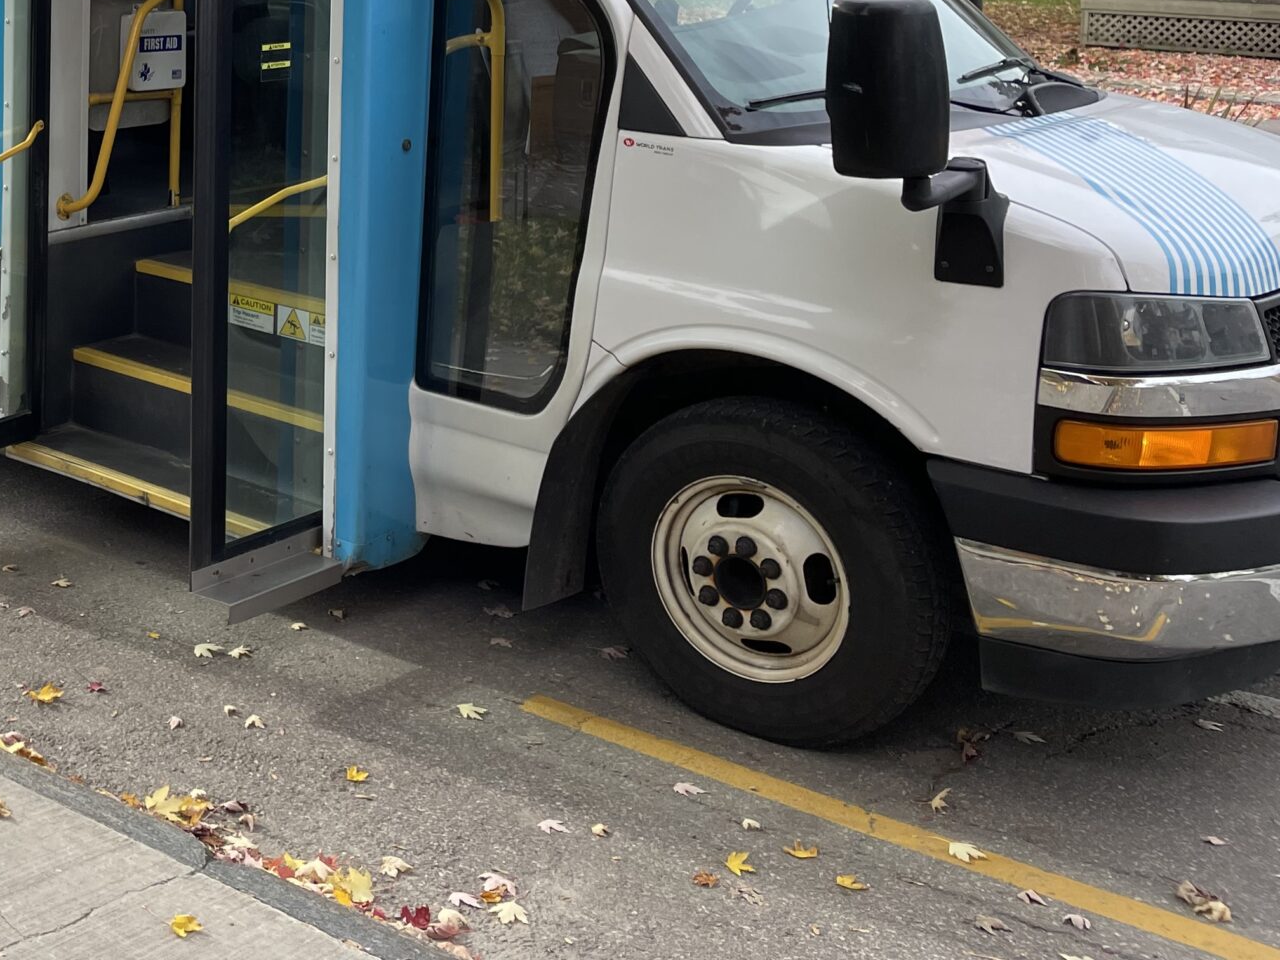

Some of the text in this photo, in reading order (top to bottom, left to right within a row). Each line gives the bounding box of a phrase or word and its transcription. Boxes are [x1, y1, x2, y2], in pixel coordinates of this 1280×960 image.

[144, 36, 178, 50] FIRST AID
[240, 298, 271, 311] CAUTION
